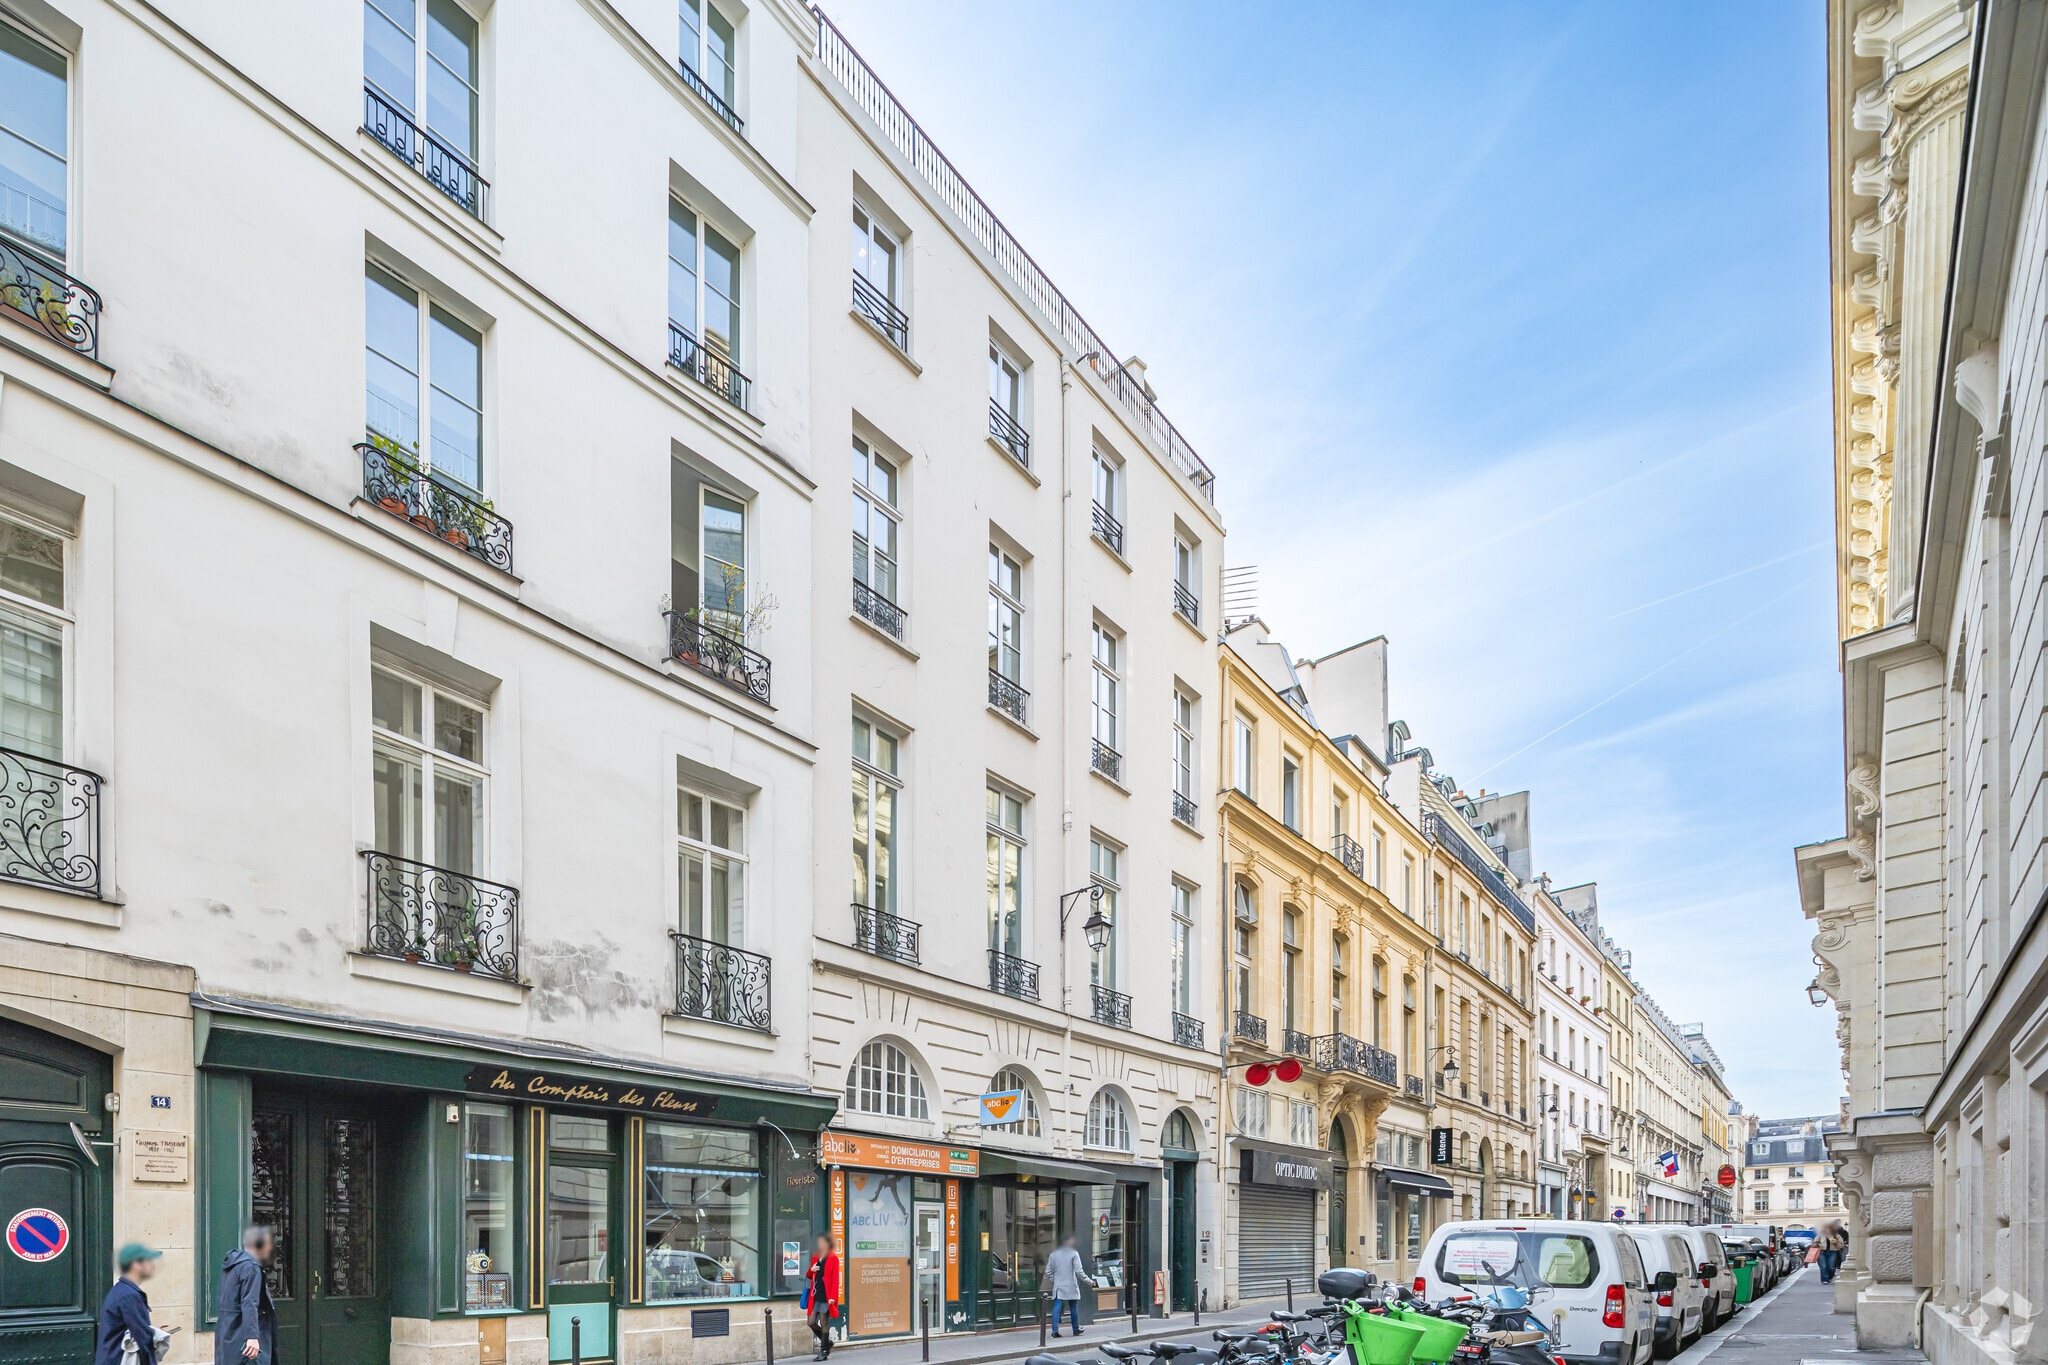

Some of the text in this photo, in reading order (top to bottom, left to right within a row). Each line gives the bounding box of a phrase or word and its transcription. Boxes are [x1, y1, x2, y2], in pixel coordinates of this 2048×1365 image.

[490, 1070, 698, 1112] Au Comptoir des Fleurs
[154, 1097, 167, 1107] 14
[891, 1145, 940, 1159] DOMICILIATION
[1437, 1131, 1447, 1161] Listener
[891, 1155, 940, 1169] D'ENTREPRISES
[1275, 1161, 1318, 1180] OPTIC DUROC
[10, 1210, 66, 1232] STATIONNEMENT INTERDIT
[851, 1216, 871, 1226] ABC
[872, 1212, 890, 1226] LIV
[1201, 1230, 1211, 1238] 12
[21, 1251, 37, 1260] JOUR
[43, 1250, 56, 1260] NUIT
